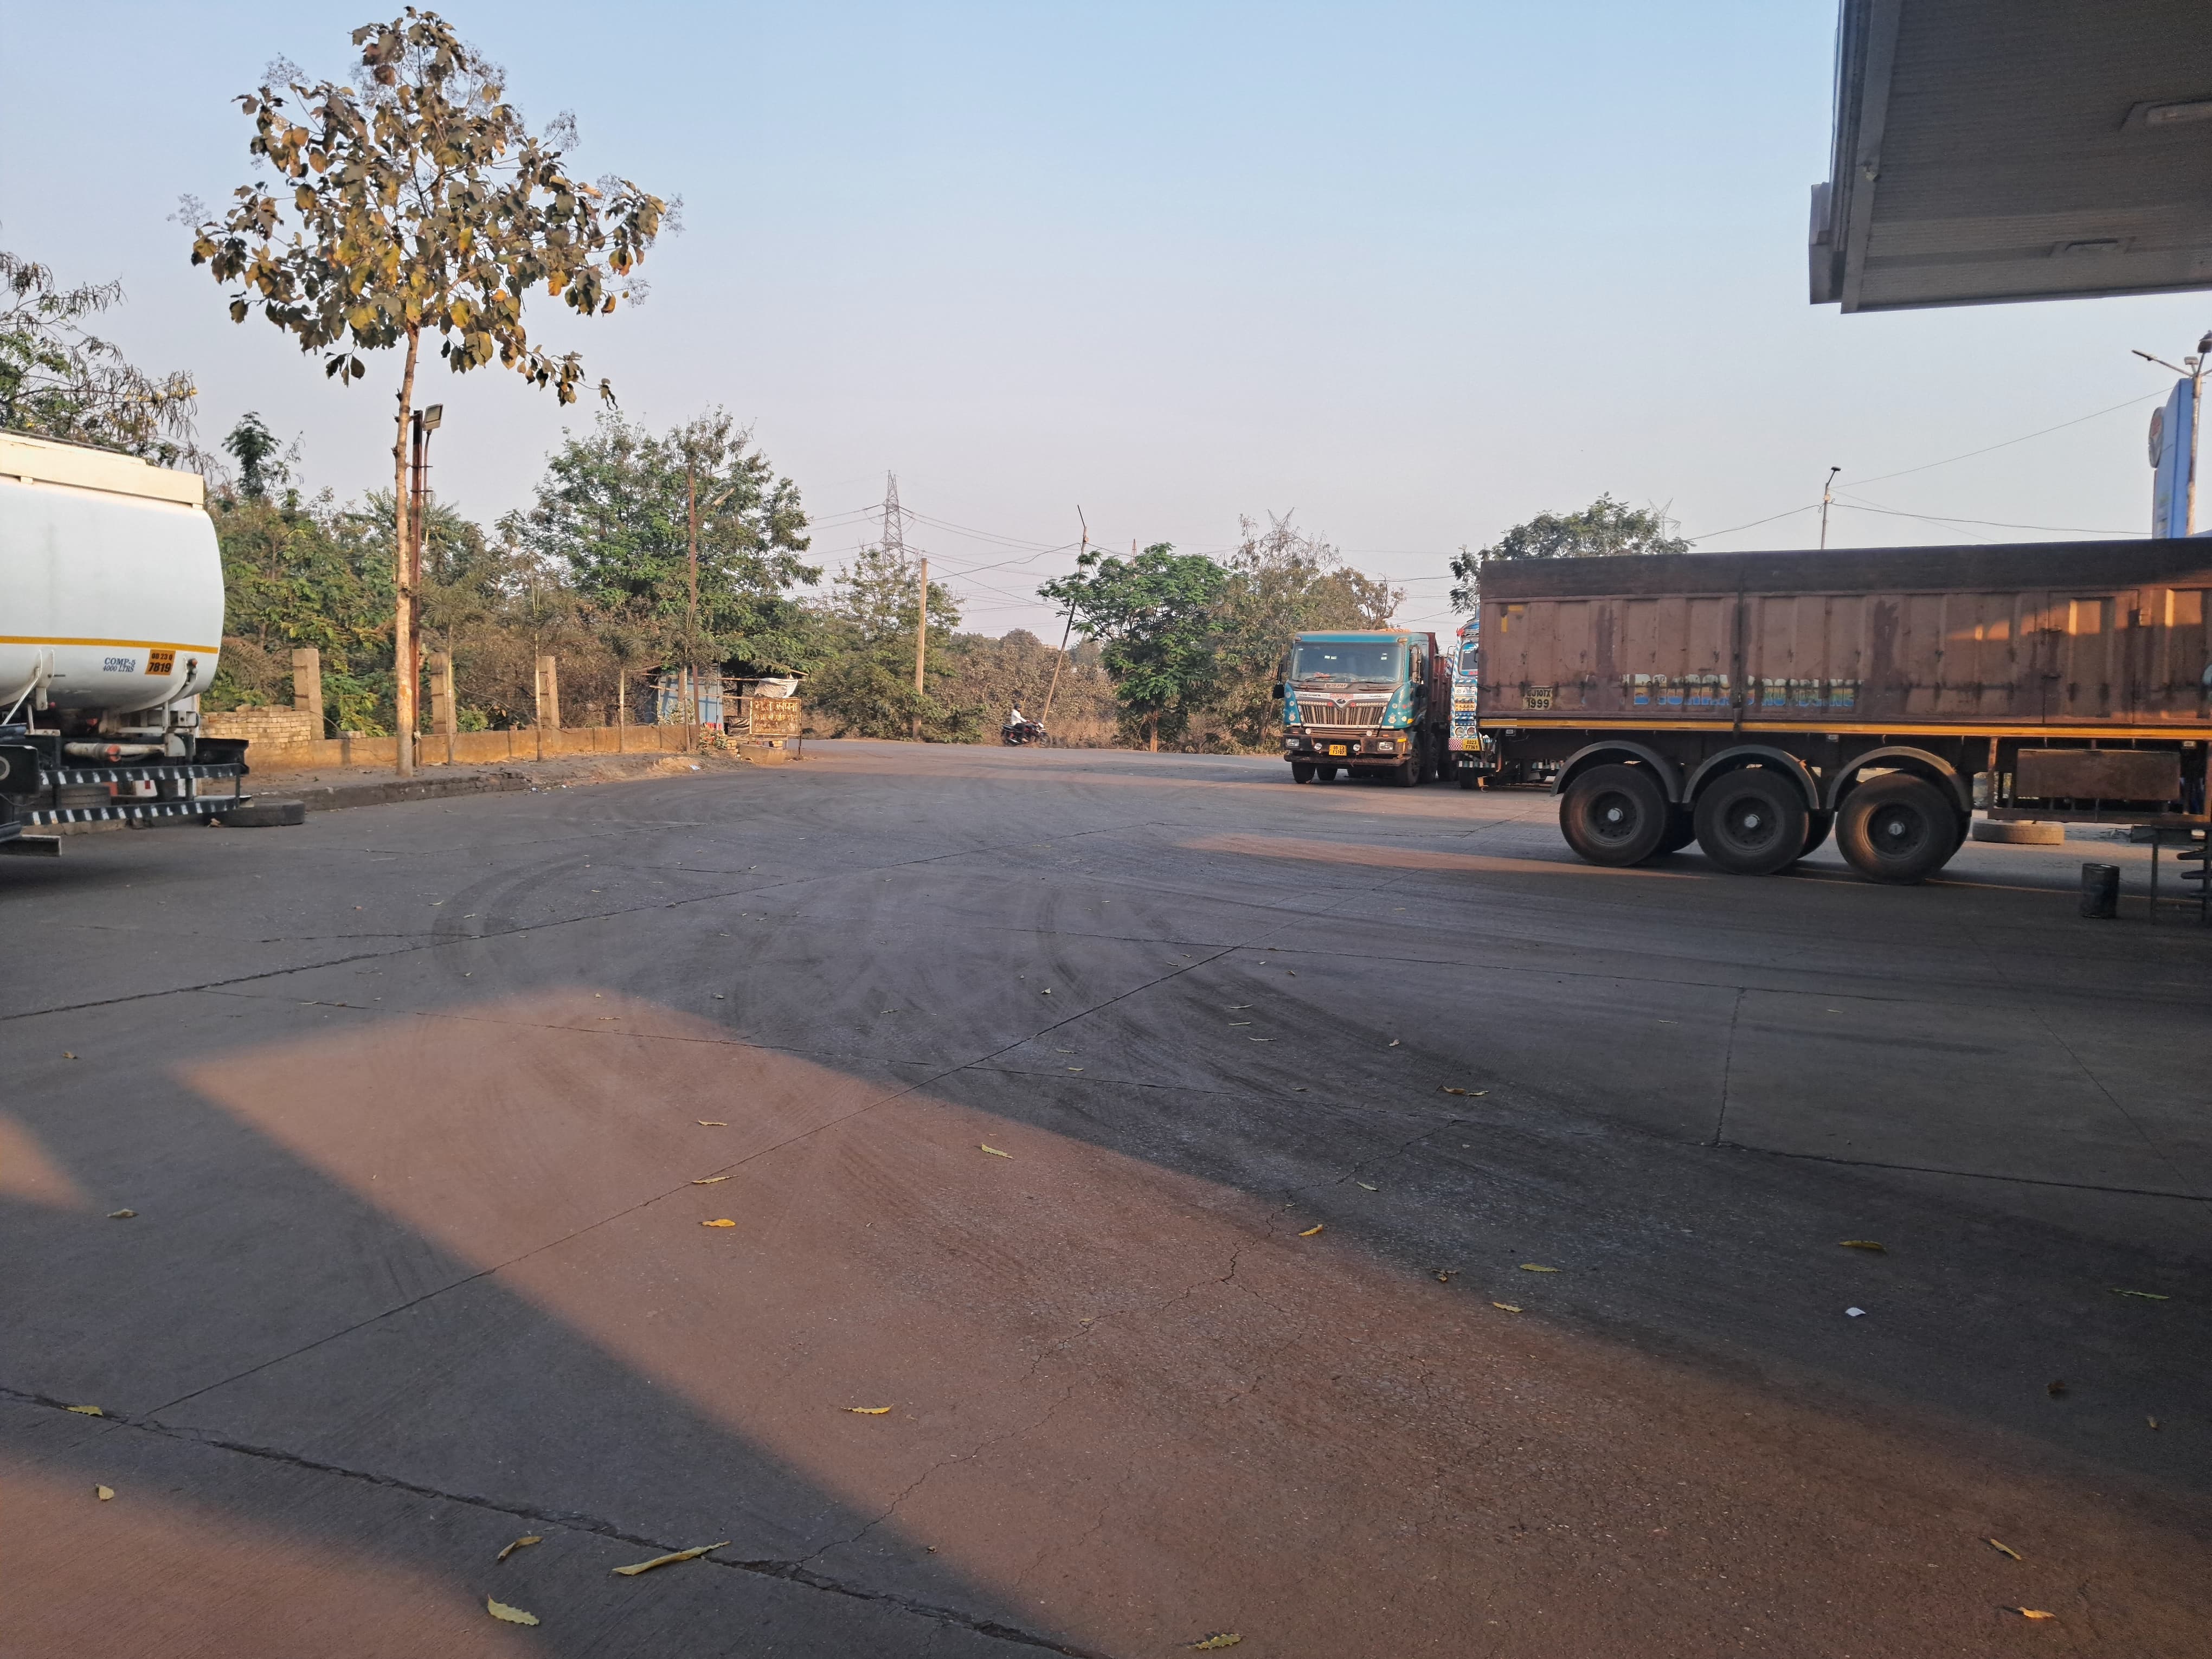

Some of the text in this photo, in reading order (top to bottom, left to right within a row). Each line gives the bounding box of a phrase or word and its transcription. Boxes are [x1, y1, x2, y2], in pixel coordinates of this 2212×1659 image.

[104, 657, 136, 665] COMP-5
[148, 662, 171, 673] 7819
[1527, 698, 1549, 709] 1999
